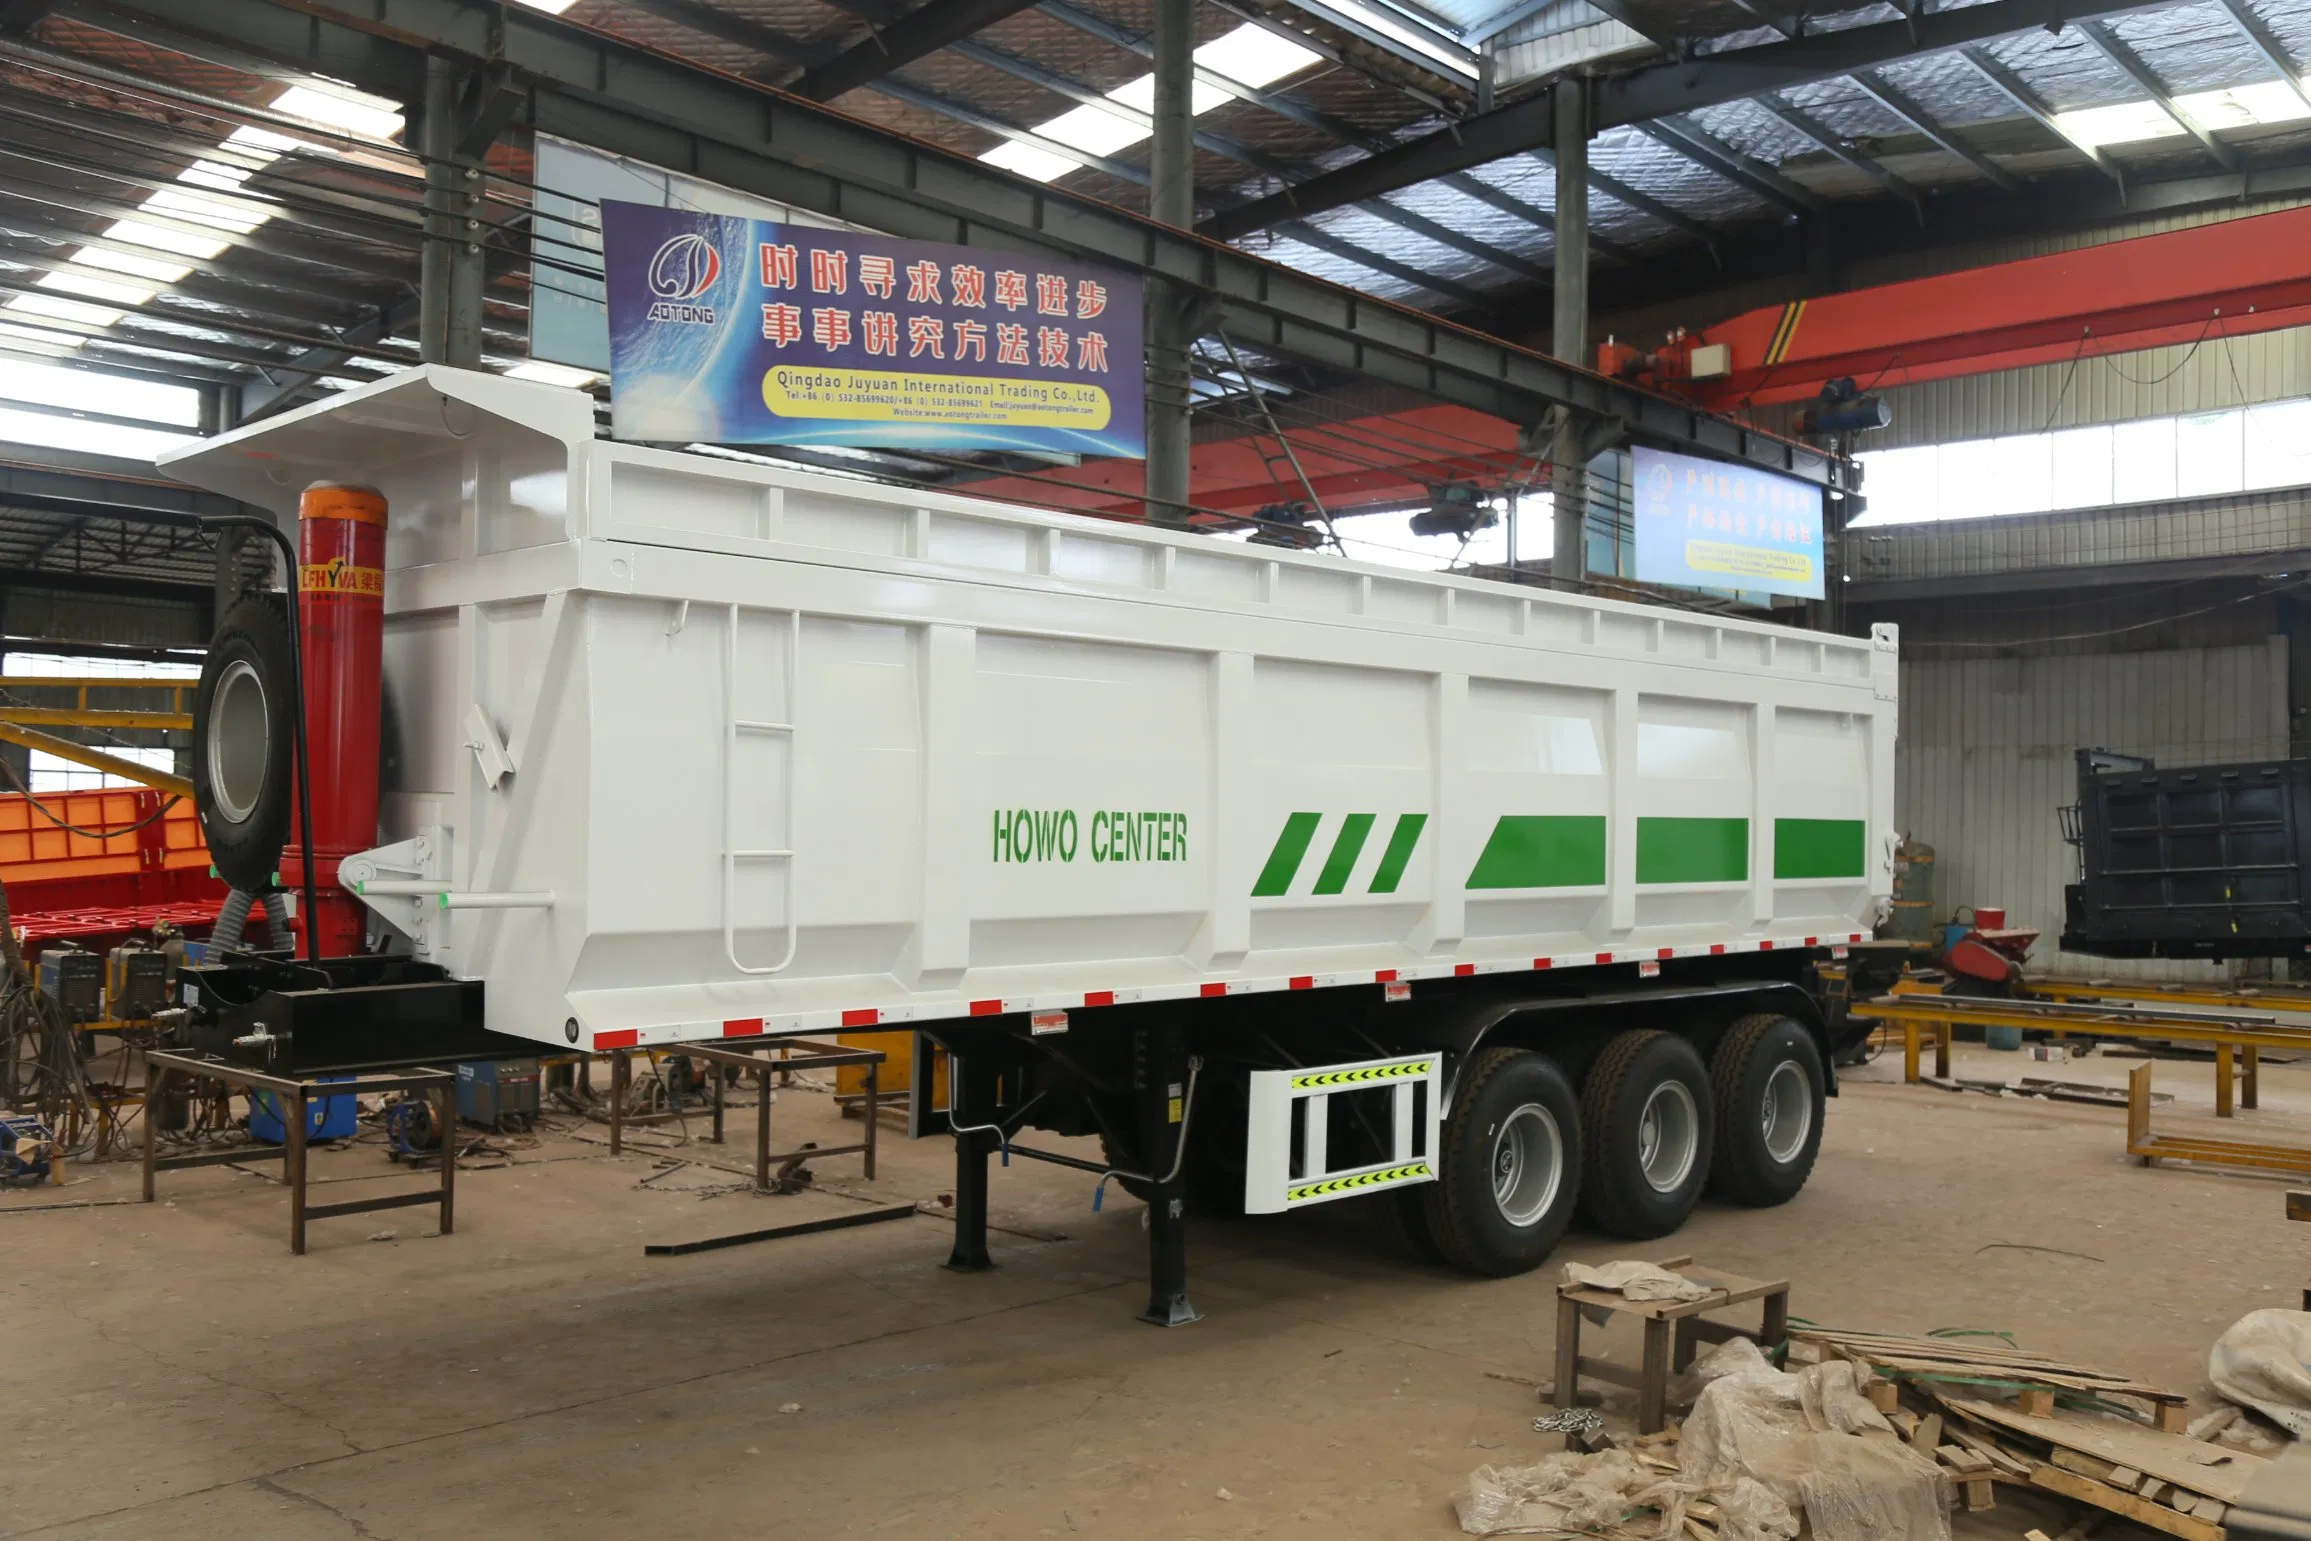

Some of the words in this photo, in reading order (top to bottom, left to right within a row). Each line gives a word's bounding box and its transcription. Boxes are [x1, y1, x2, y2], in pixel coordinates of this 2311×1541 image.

[760, 244, 1106, 318] 时时寻求效率进步
[647, 302, 715, 325] AOTONG
[762, 303, 1108, 372] 事事讲究方法技术
[777, 371, 841, 390] Qingdao
[847, 375, 898, 392] Juyuan
[904, 379, 994, 396] International
[1000, 384, 1048, 401] Trading
[1052, 388, 1100, 403] Co.,Ltd.
[993, 809, 1078, 863] HOWO
[1091, 810, 1187, 863] CENTER
